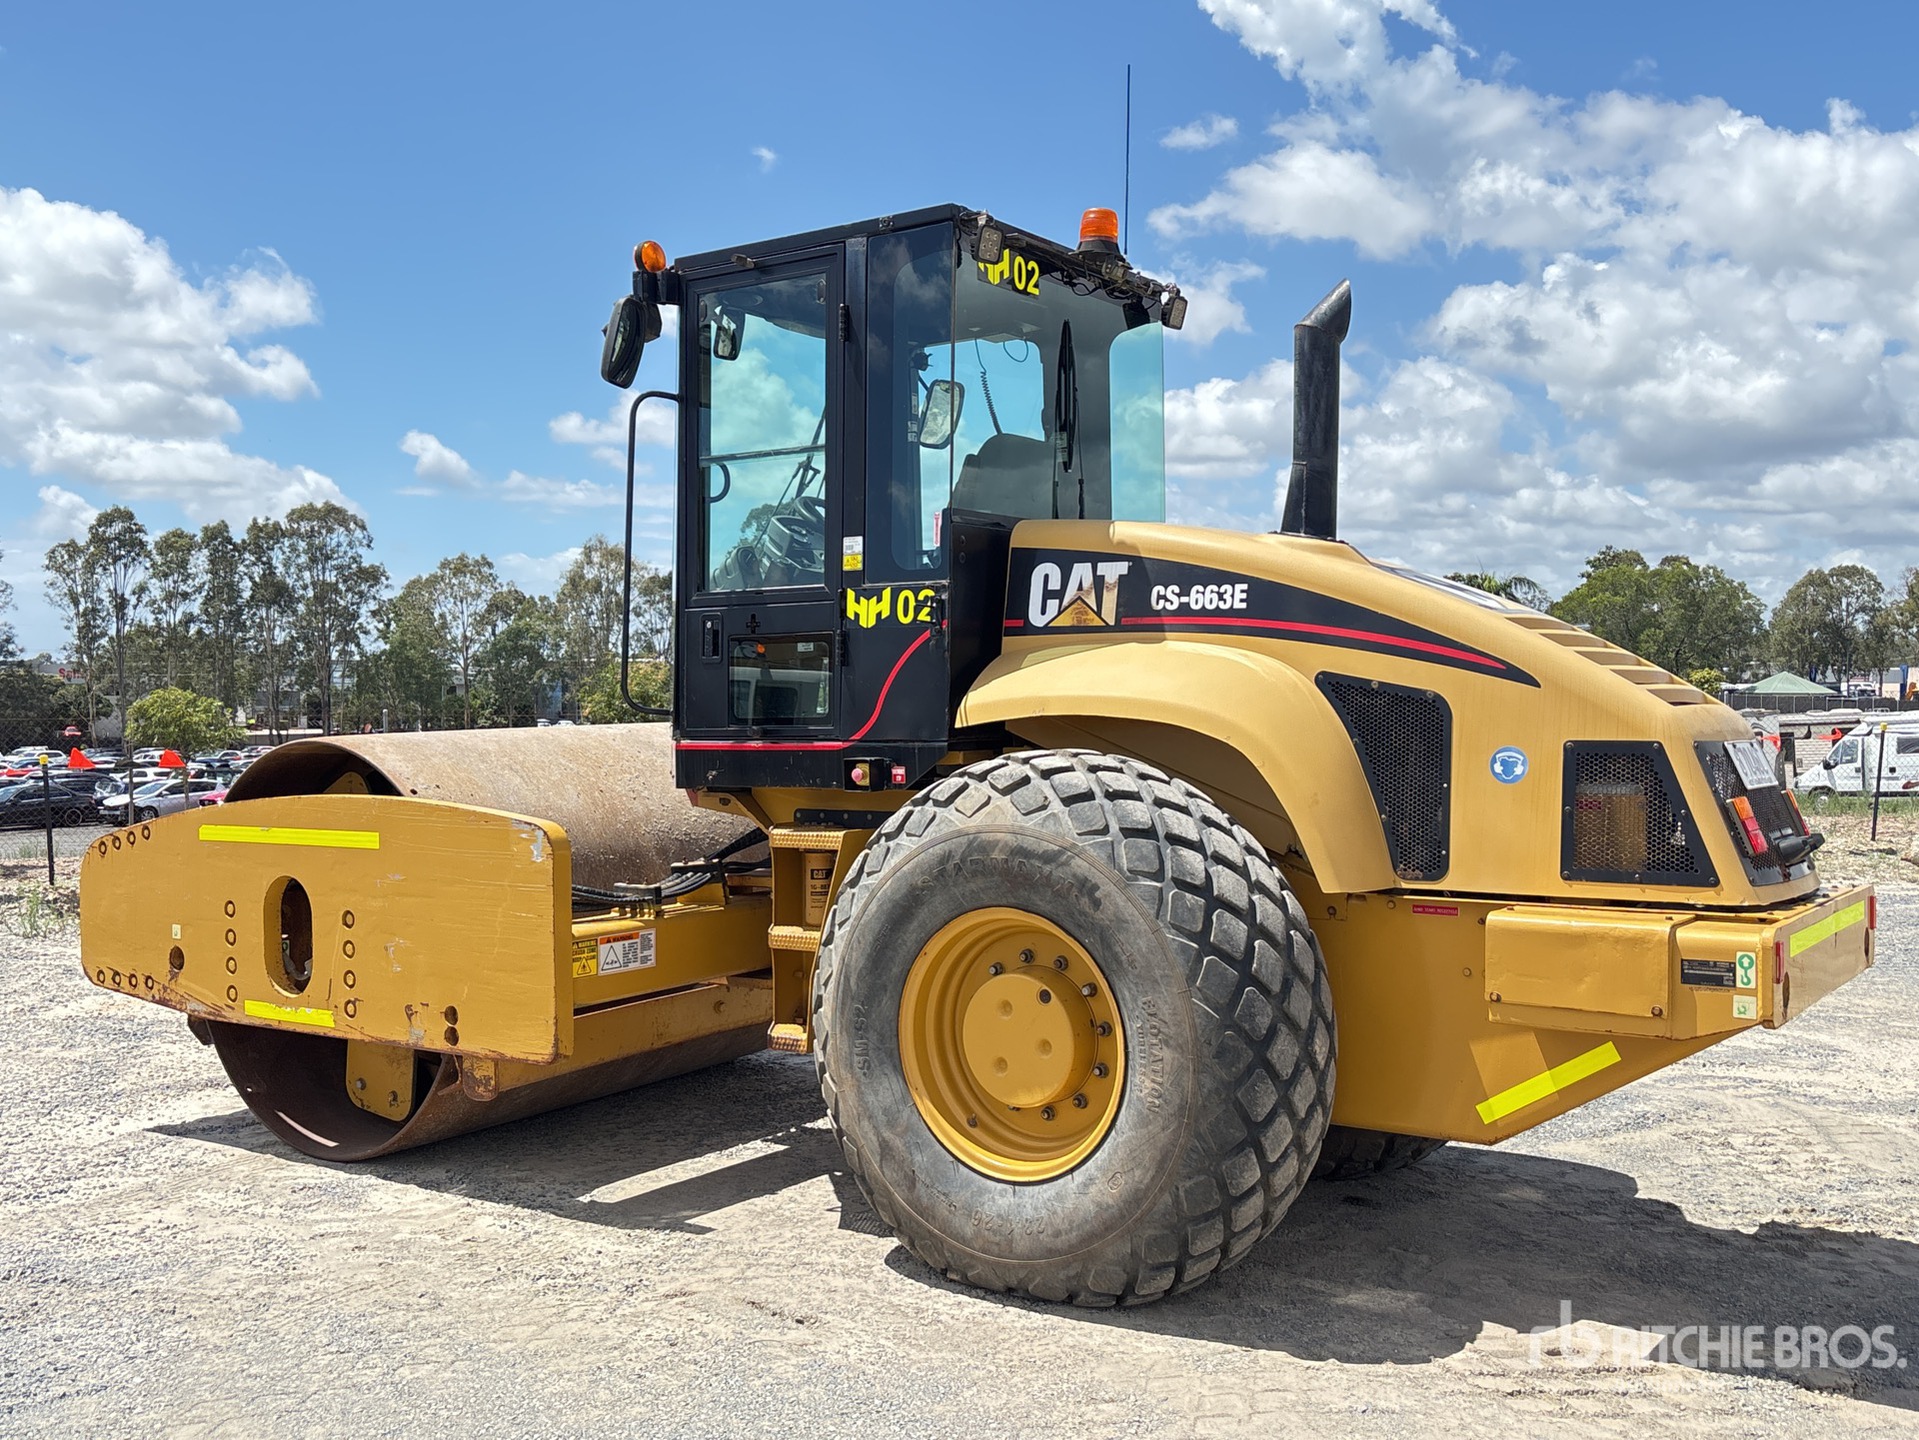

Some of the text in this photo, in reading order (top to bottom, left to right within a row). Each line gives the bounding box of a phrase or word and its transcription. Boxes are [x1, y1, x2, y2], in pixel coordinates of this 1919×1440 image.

[1013, 255, 1040, 296] 02
[896, 588, 936, 625] 02
[1028, 561, 1129, 627] CAT
[1150, 583, 1249, 611] CS-663E
[812, 870, 827, 879] CAT
